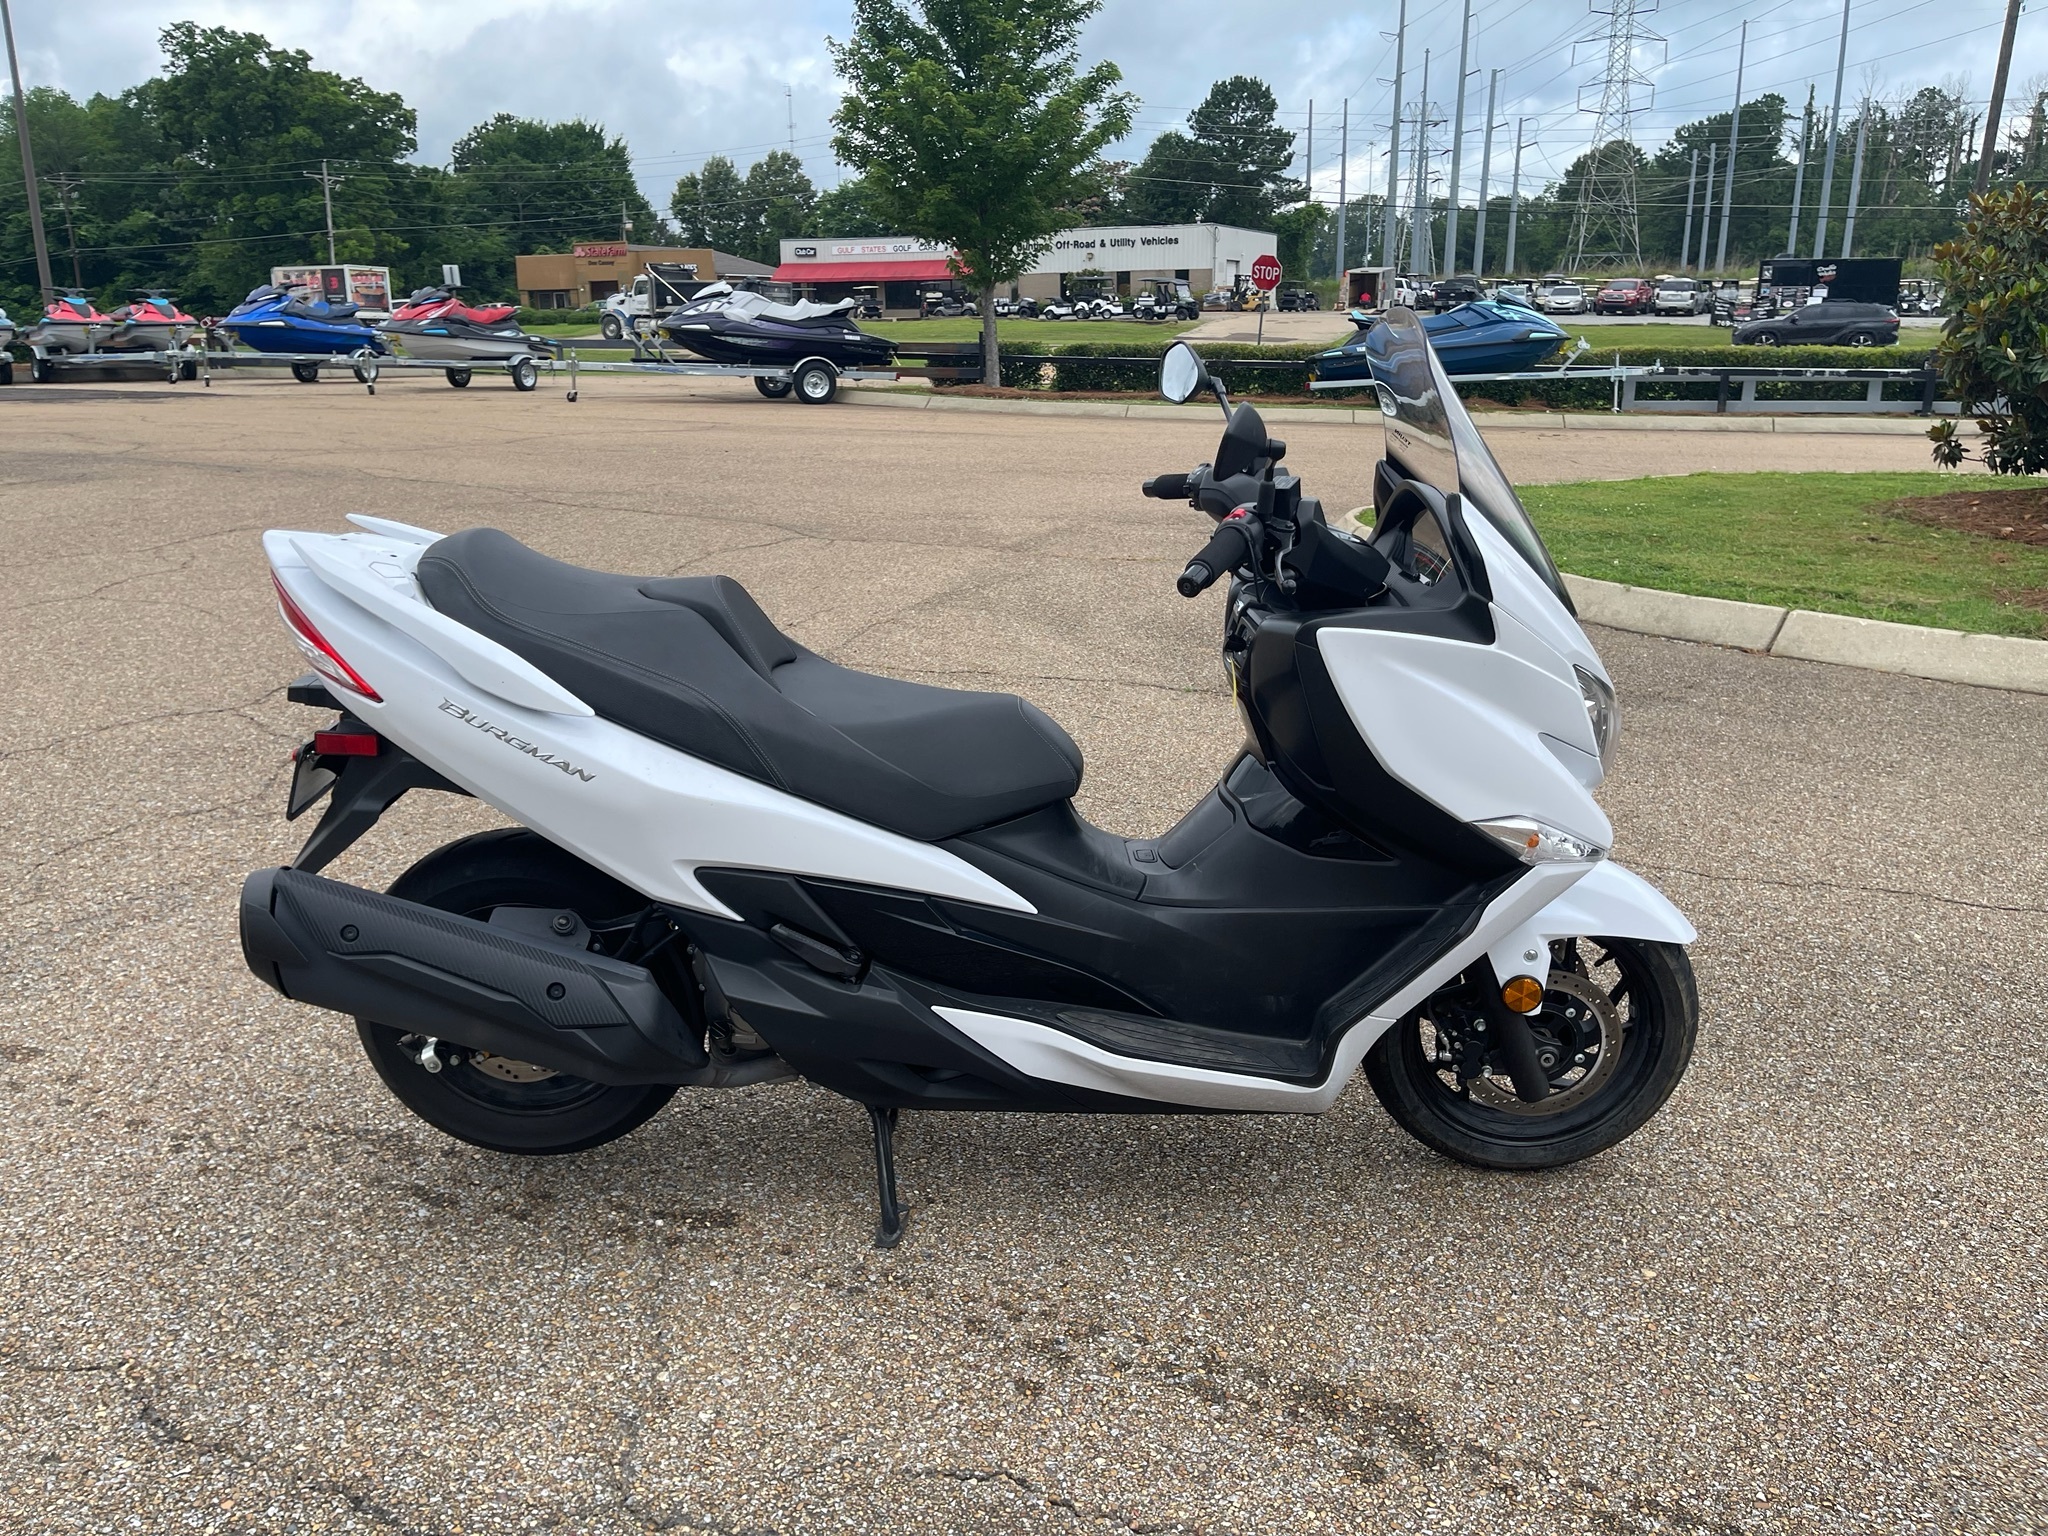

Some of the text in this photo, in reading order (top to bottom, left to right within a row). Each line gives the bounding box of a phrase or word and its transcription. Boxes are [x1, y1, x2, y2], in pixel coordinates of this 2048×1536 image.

[837, 246, 854, 254] GULF
[861, 246, 887, 254] STATES
[1055, 239, 1096, 250] Off-Road
[1100, 239, 1106, 247] &
[1110, 237, 1136, 248] Utility
[1140, 235, 1179, 246] Vehicles
[1253, 265, 1280, 280] STOP
[437, 697, 597, 782] BURGMAN
